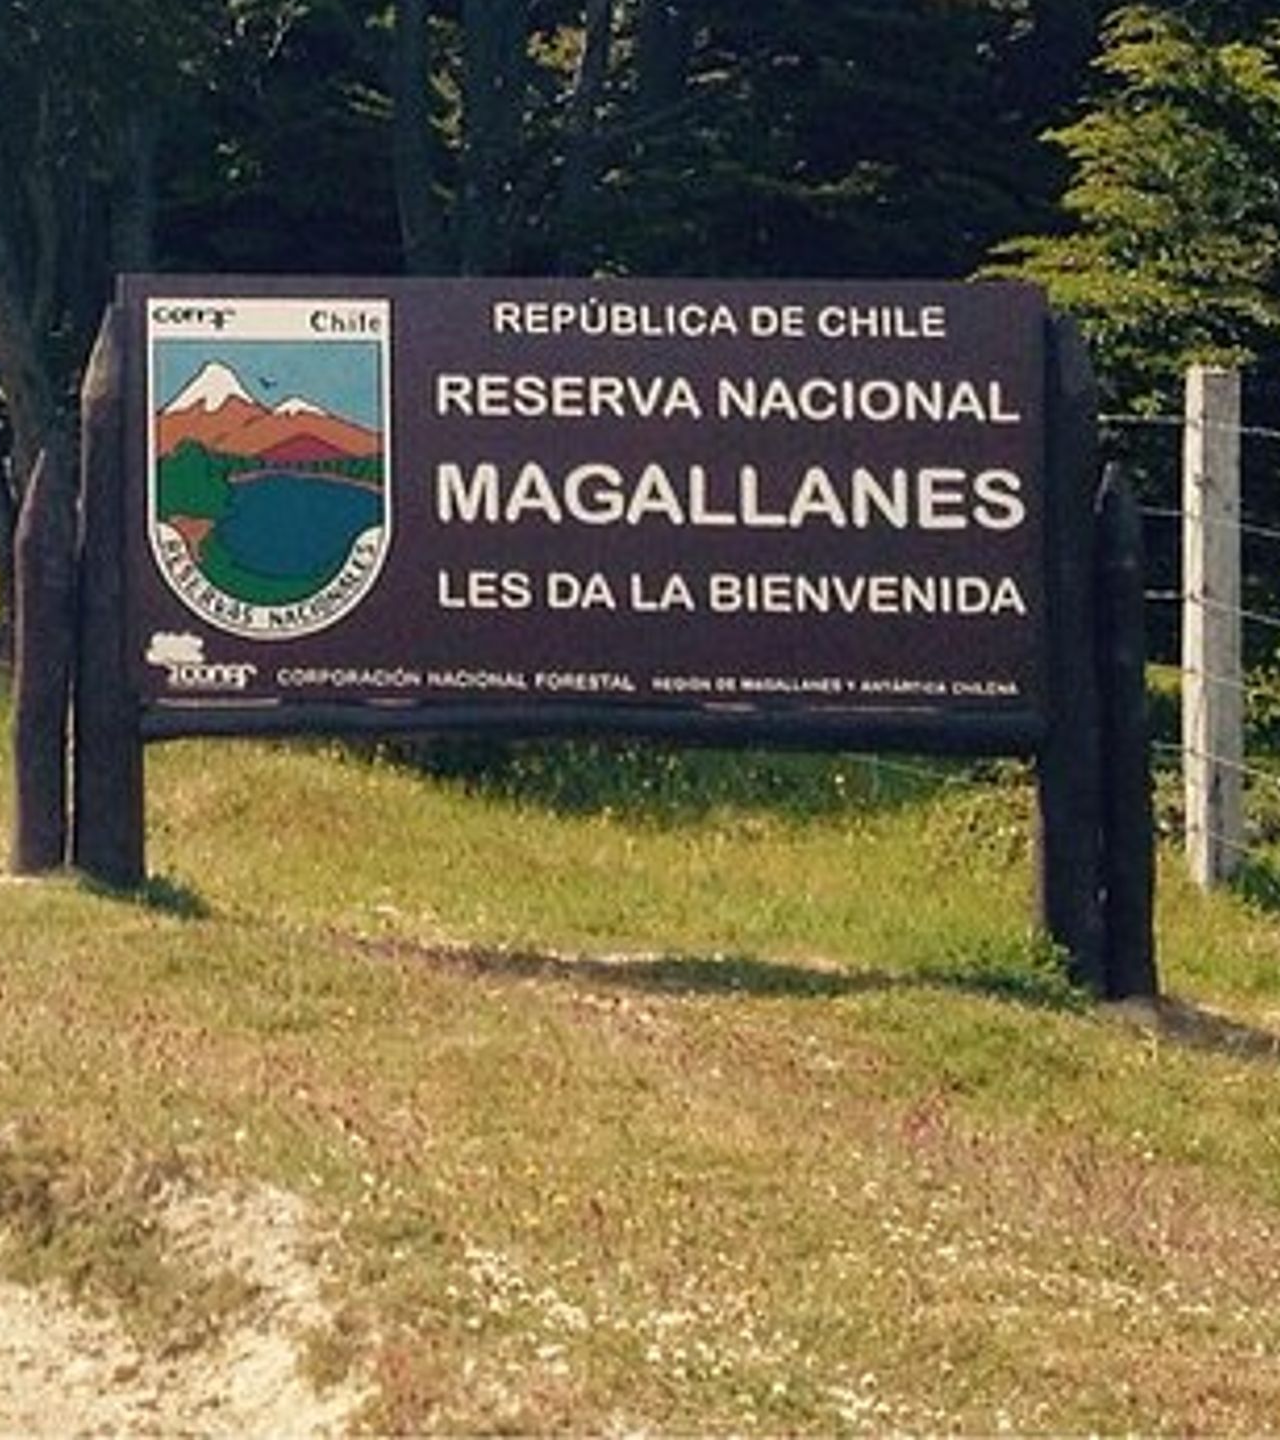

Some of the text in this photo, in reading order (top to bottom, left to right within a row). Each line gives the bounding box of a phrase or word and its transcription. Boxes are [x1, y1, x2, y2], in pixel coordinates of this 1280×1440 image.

[308, 309, 381, 333] Chile
[493, 297, 946, 338] REPÚBLICA DE CHILE
[437, 375, 1021, 423] RESERVA NACIONAL
[437, 462, 1026, 530] MAGALLANES
[438, 570, 1028, 615] LES DA LA BIENVENIDA
[276, 667, 636, 692] CORPORACIÓN NACIONAL FORESTAL
[715, 678, 737, 691] DE
